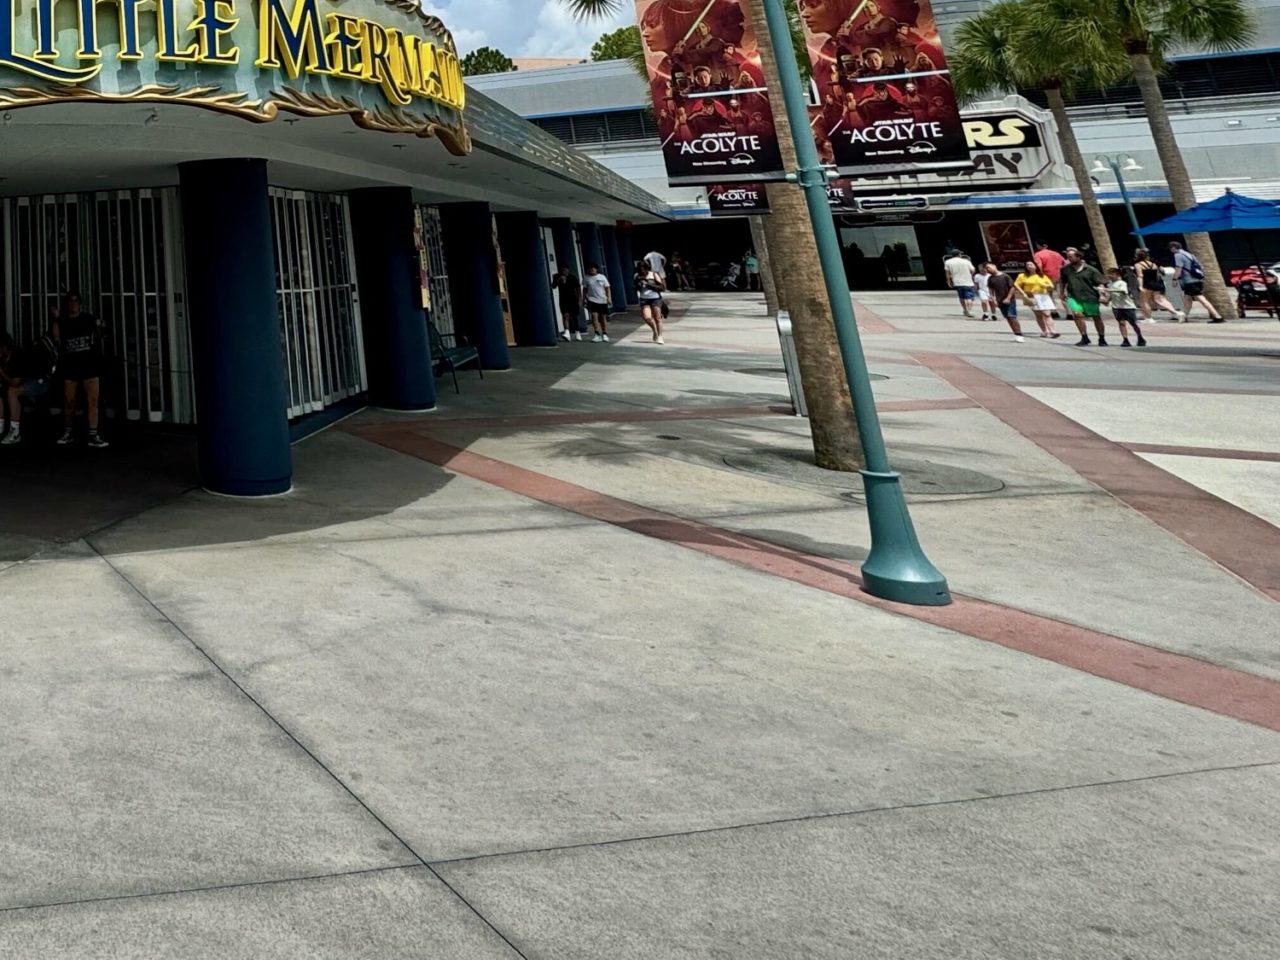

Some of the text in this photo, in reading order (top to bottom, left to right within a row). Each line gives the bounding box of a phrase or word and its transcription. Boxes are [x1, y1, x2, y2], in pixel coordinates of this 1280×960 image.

[850, 121, 944, 144] ACOLYTE
[961, 117, 1032, 148] RS
[680, 135, 761, 155] ACOLYTE
[716, 191, 759, 201] ACOLYTE
